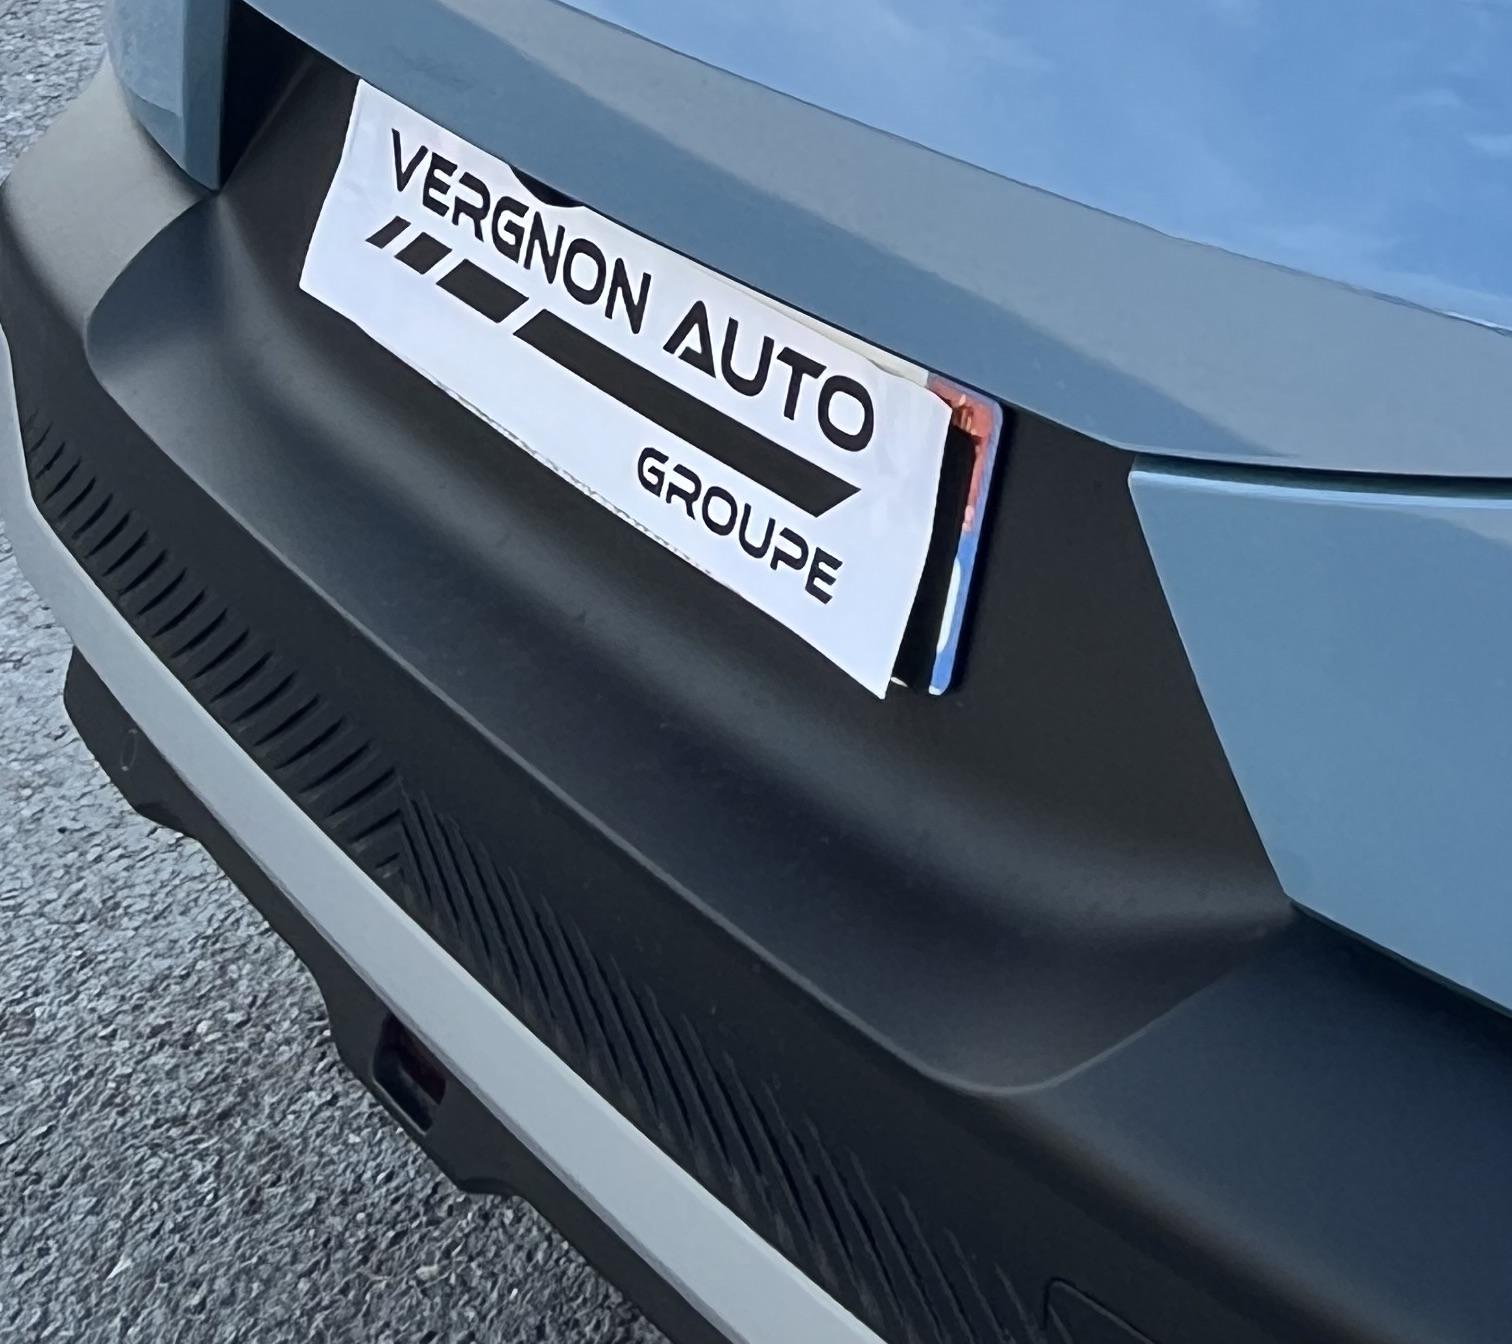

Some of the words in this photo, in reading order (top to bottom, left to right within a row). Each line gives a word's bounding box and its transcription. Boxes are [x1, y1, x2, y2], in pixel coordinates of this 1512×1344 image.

[391, 128, 652, 335] VERGNON
[662, 300, 875, 452] AUTO
[637, 447, 843, 605] GROUPE
